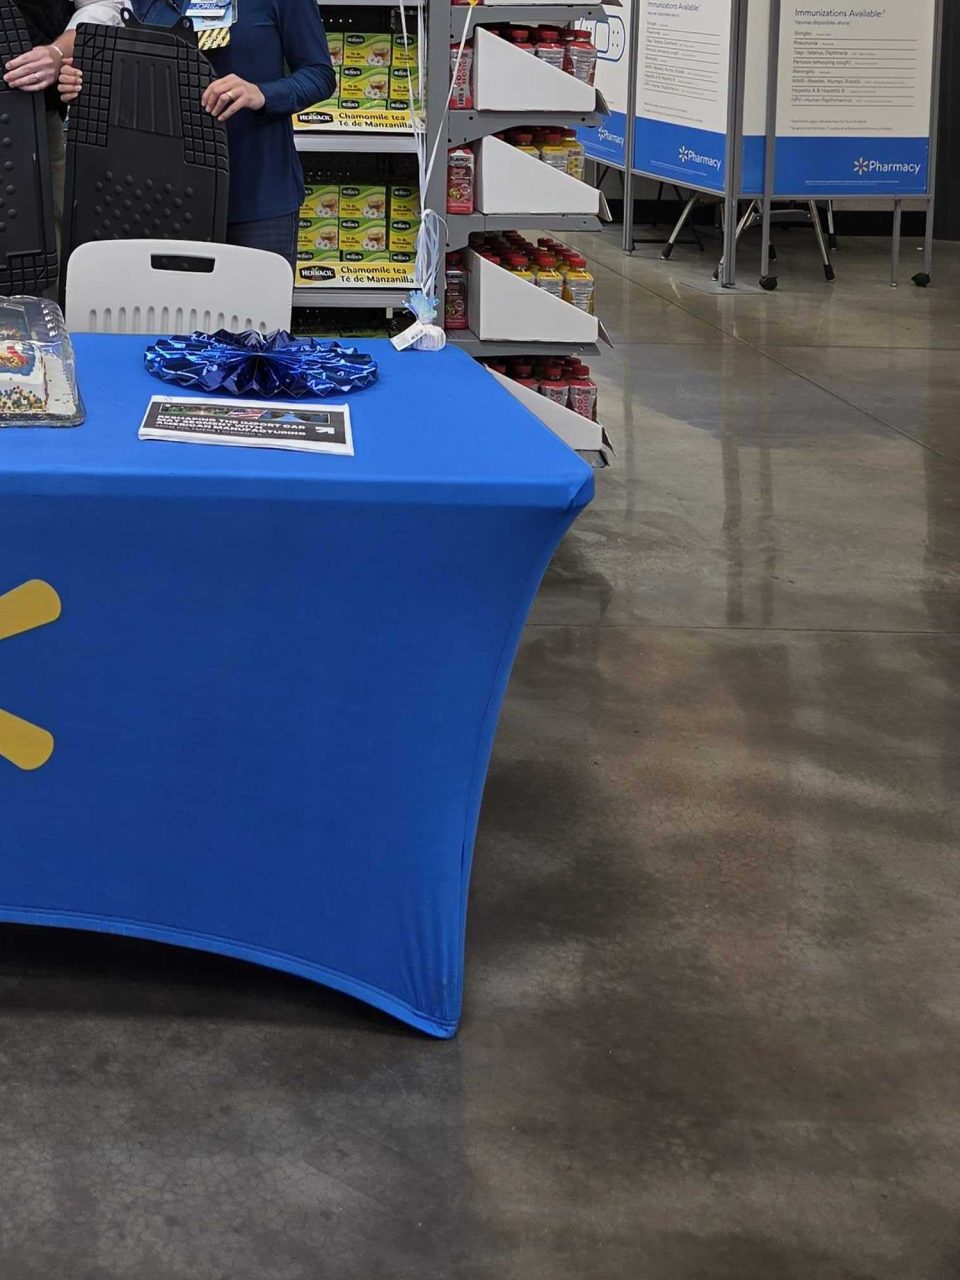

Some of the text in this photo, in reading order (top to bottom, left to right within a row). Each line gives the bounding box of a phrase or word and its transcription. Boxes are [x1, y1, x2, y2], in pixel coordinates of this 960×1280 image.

[795, 9, 847, 17] Immunizations
[365, 121, 413, 129] Manzanilla
[688, 150, 722, 171] Pharmacy
[869, 160, 921, 175] Pharmacy
[341, 266, 390, 274] Chamomile
[367, 276, 415, 284] Manzanilla
